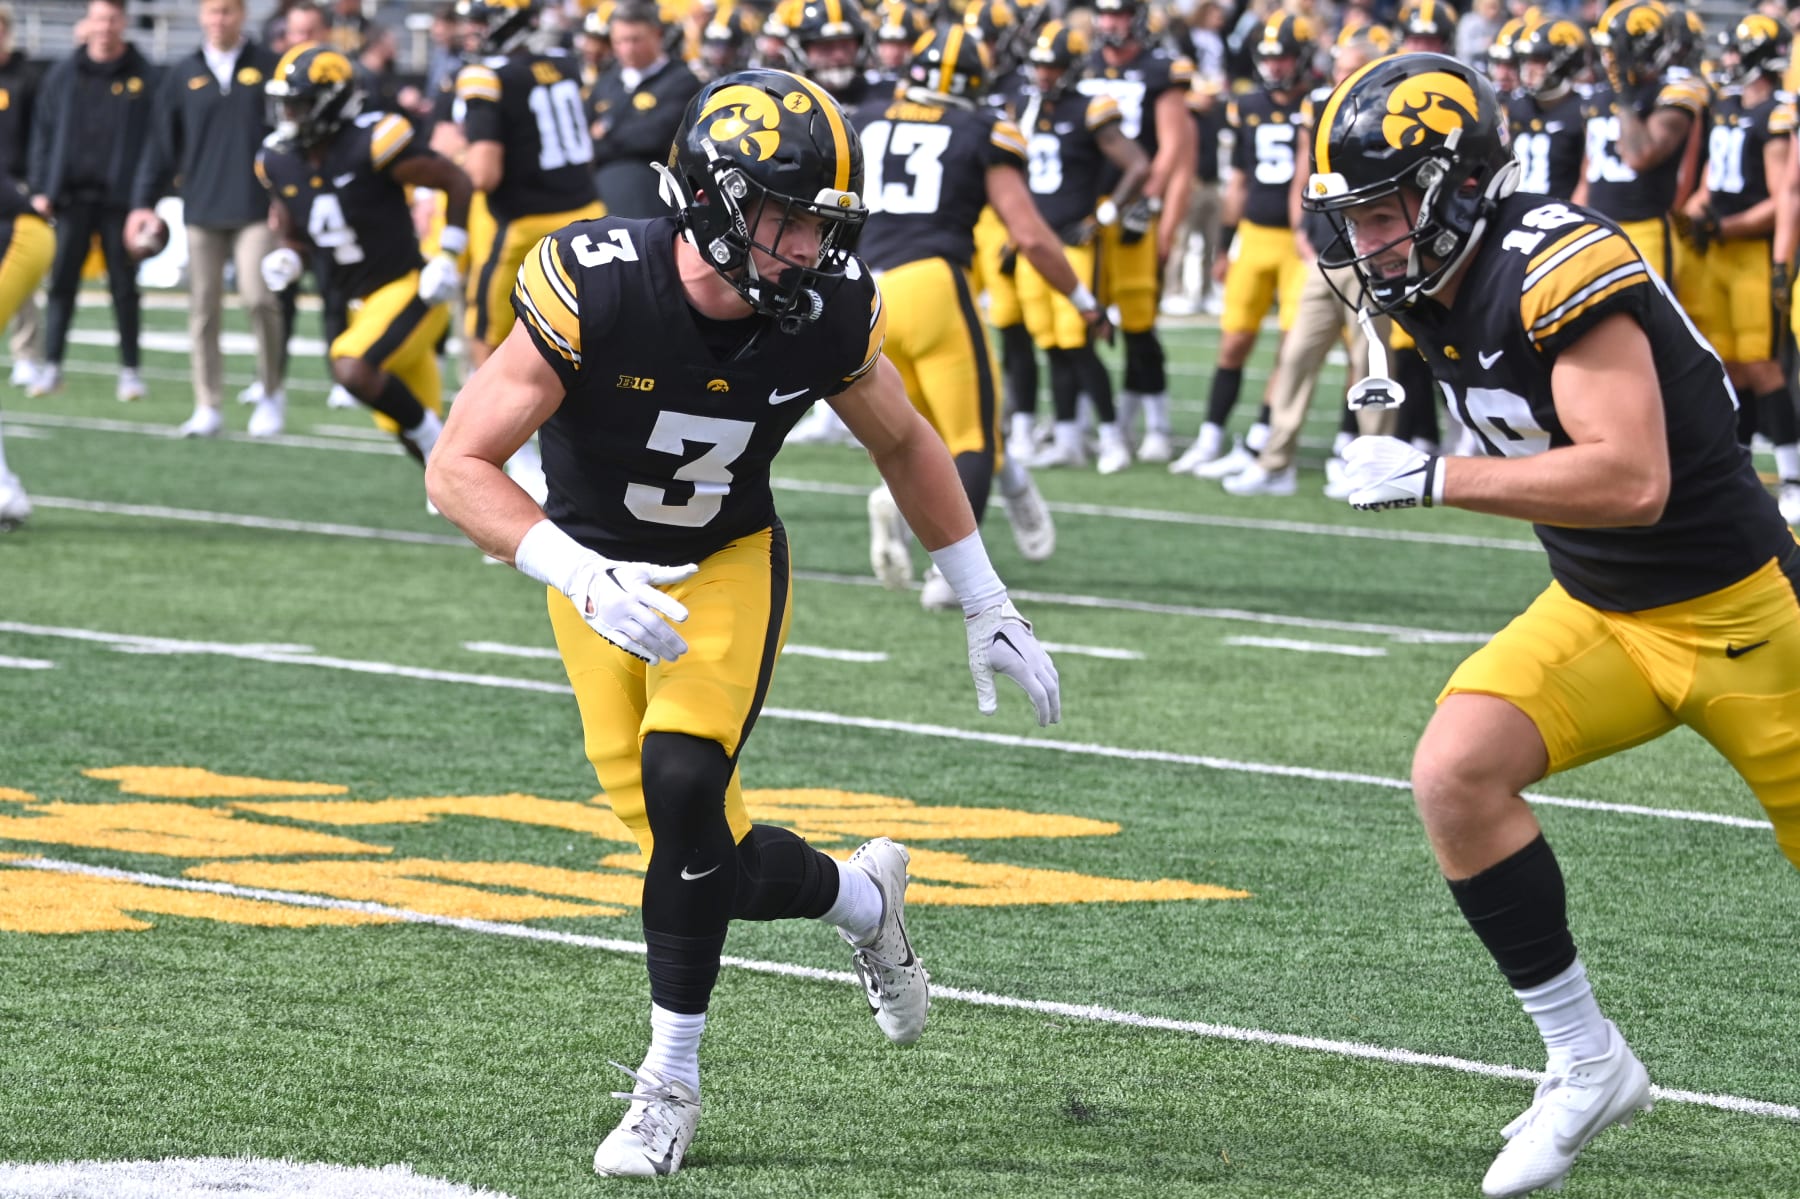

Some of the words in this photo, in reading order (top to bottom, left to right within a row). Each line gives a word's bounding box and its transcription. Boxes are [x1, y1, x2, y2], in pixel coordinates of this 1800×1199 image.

[528, 79, 594, 170] 10
[1255, 123, 1295, 185] 5
[1706, 125, 1746, 194] 81
[861, 120, 952, 215] 13
[307, 193, 365, 265] 4
[570, 229, 640, 268] 3
[1502, 203, 1584, 256] 18
[624, 410, 756, 527] 3
